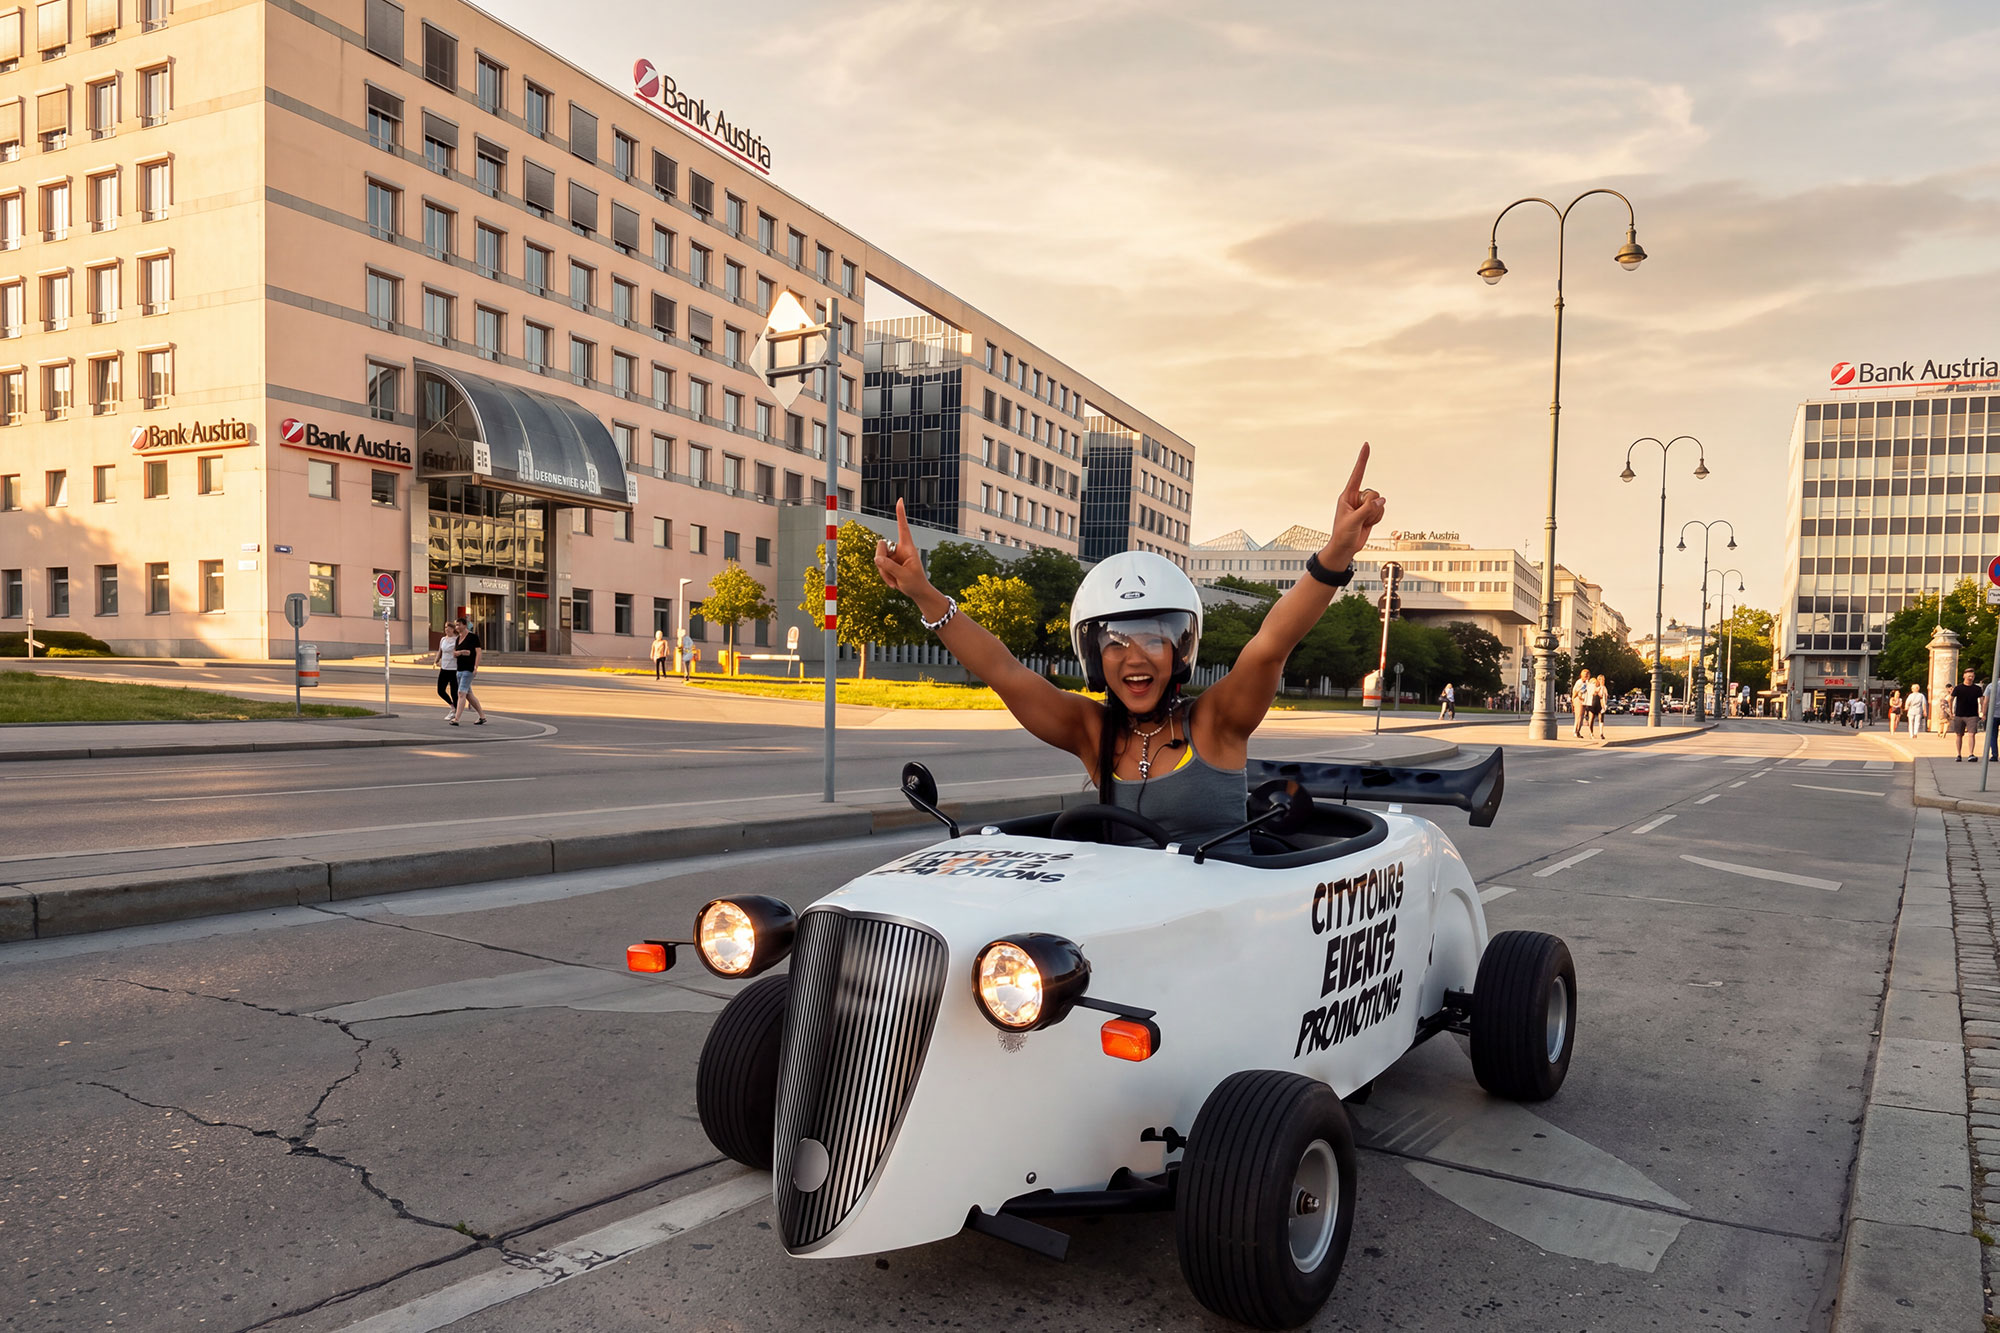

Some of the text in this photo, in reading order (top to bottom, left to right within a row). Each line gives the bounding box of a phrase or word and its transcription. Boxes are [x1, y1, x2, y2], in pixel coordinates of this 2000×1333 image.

[663, 74, 771, 169] Bank Austria
[1859, 357, 1999, 383] Bank Austria
[150, 417, 247, 447] Bank Austria
[306, 423, 351, 451] Bank
[354, 433, 411, 464] Austria
[1403, 530, 1460, 541] Bank Austria
[1311, 861, 1404, 935] CITYTOURS
[1320, 914, 1397, 999] EVENTS
[1293, 969, 1404, 1060] PROMOTIONS
